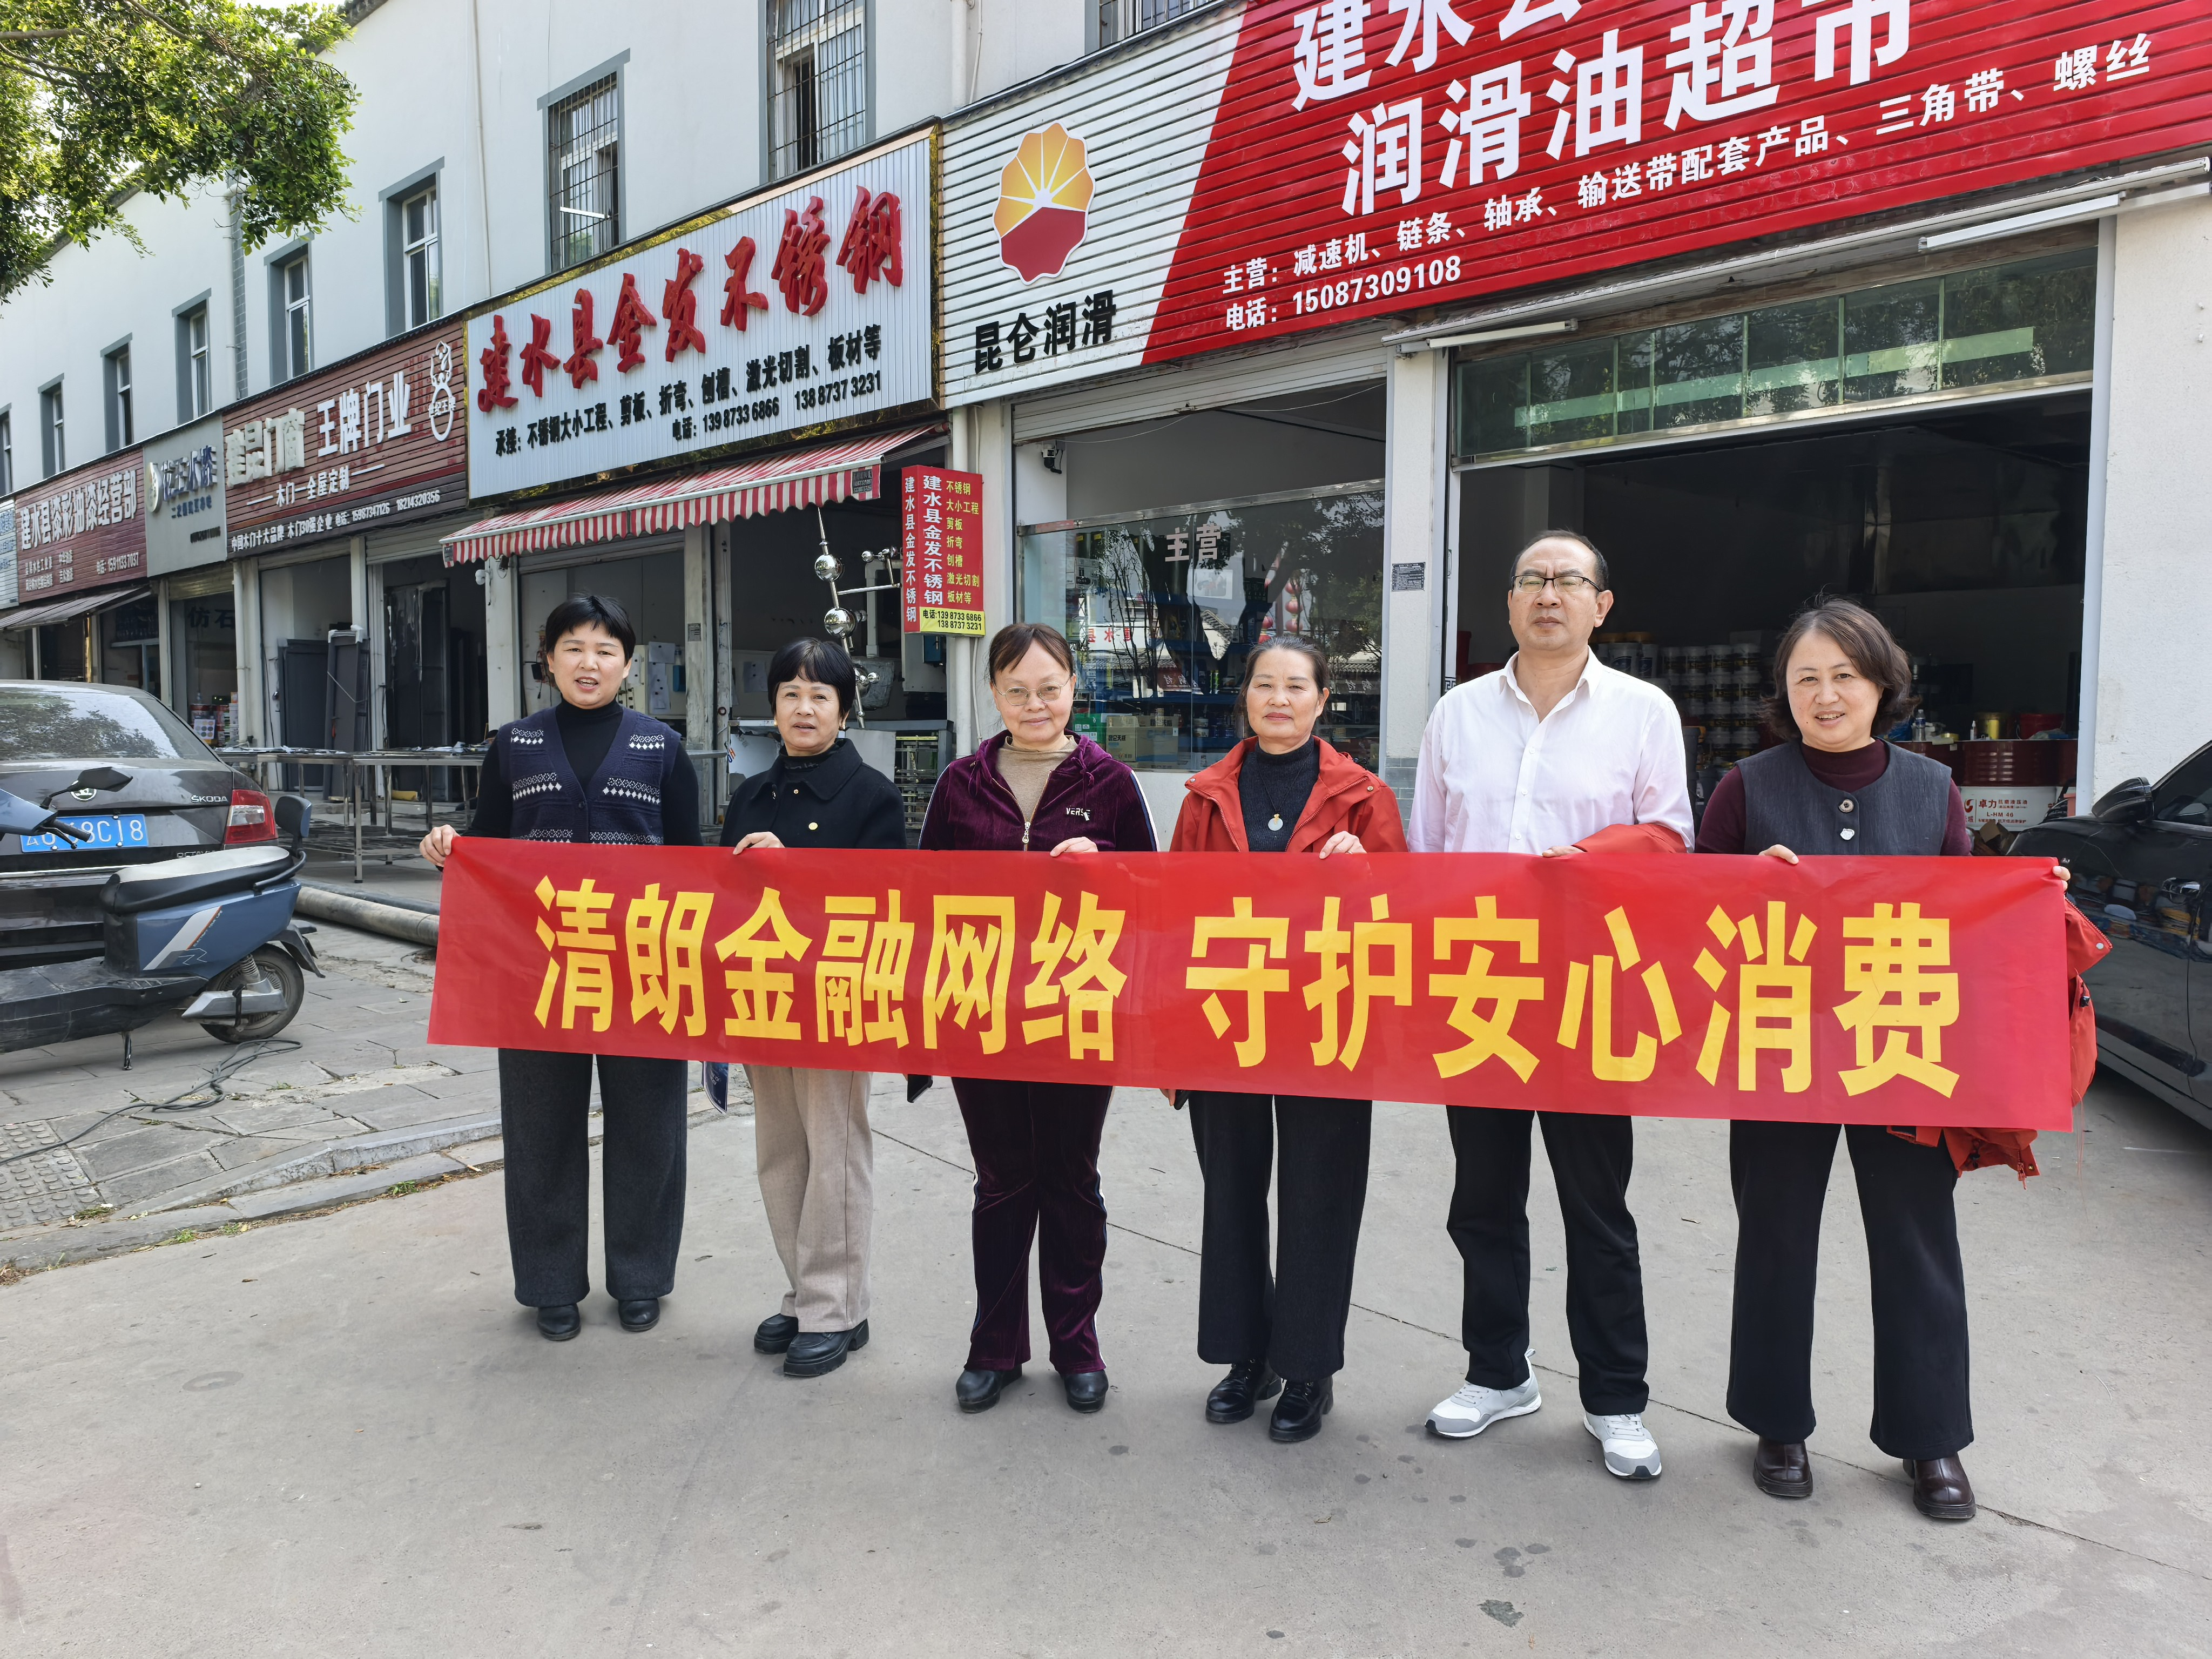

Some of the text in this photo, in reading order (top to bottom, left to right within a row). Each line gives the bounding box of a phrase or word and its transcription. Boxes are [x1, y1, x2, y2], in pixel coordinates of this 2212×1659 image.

[1341, 0, 1910, 217] 润滑油超市
[477, 185, 903, 413] 建水县金发不锈钢
[974, 288, 1117, 375] 昆仑润滑
[317, 371, 412, 457] 王牌门业
[946, 480, 971, 496] 不锈钢
[946, 499, 979, 515] 大小工程
[231, 524, 284, 552] 中国木门十大品牌
[946, 517, 963, 531] 剪板
[905, 475, 916, 623] 建水县金发不锈钢
[923, 475, 943, 605] 建水县金发不锈钢
[946, 535, 963, 549] 折弯
[1164, 523, 1222, 563] 主营
[947, 572, 979, 588] 激光切割
[947, 590, 972, 605] 板材等
[191, 794, 229, 802] ŠKODA
[1979, 799, 1997, 808] 卓力
[534, 875, 1961, 1098] 清朗金融网络 守护安心消费
